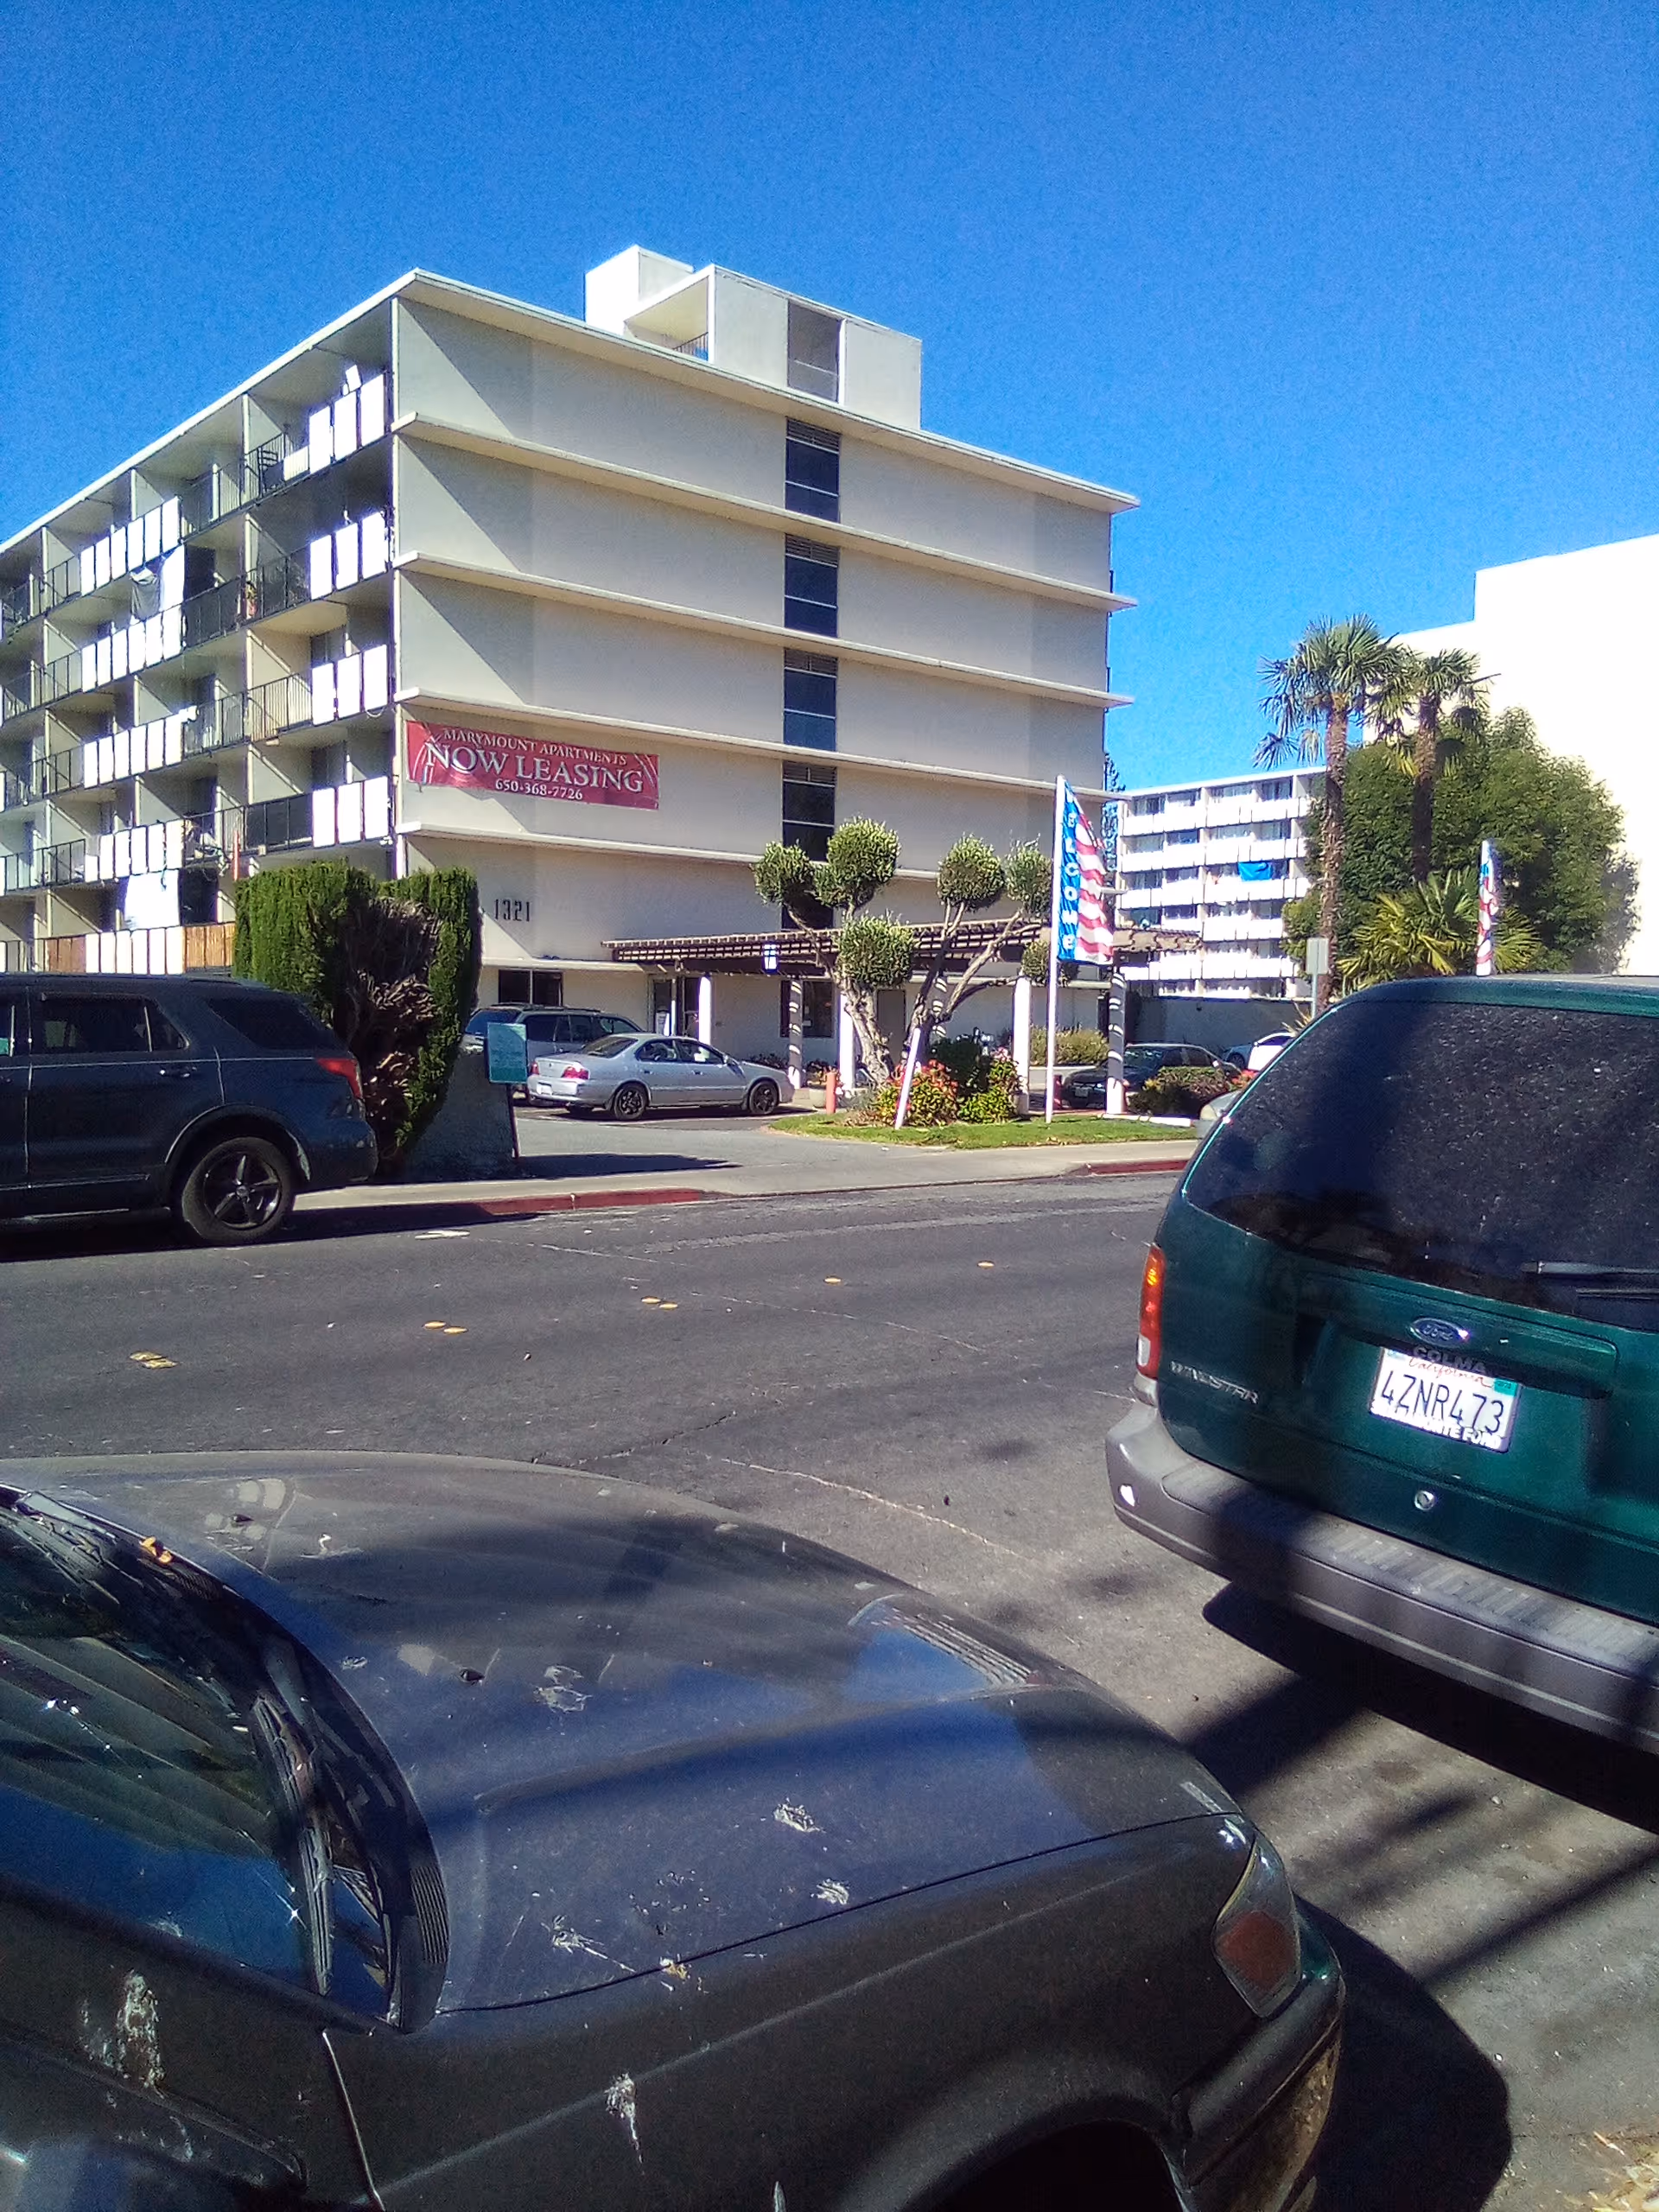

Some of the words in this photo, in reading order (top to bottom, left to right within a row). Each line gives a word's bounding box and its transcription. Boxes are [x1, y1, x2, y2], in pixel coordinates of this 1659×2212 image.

[443, 729, 537, 751] MARYMOUNT
[539, 743, 627, 766] APARTMENTS
[425, 742, 509, 775] NOW
[516, 755, 643, 792] LEASING
[495, 779, 583, 800] 650-368-7726
[493, 899, 530, 922] 1321
[1412, 1346, 1487, 1377] COLMA
[1381, 1370, 1504, 1434] 4ZNR473
